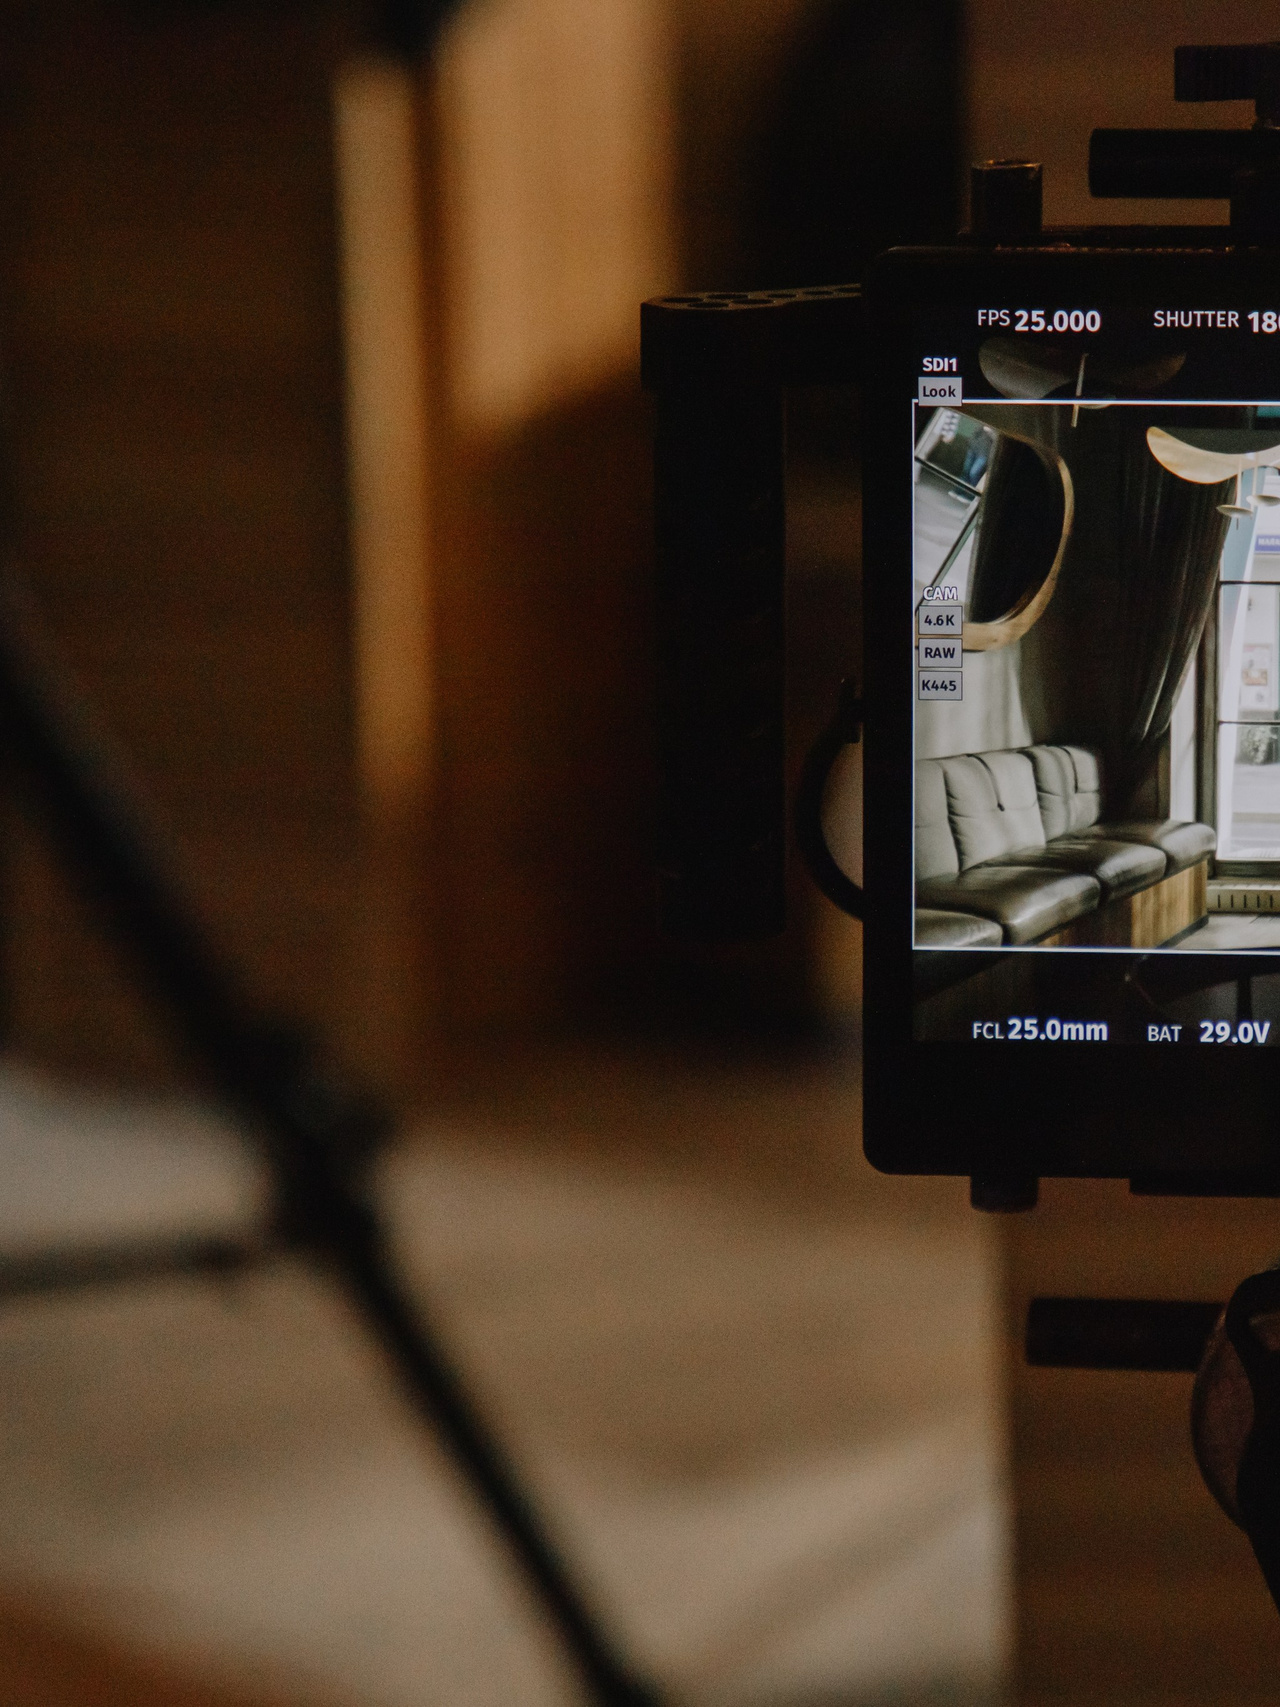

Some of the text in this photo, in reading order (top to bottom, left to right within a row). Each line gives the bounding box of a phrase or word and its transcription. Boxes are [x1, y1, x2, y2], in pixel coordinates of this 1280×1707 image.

[978, 310, 1101, 333] FPS 25.000
[1154, 310, 1239, 328] SHUTTER
[922, 357, 957, 372] SDI1
[922, 385, 957, 398] Look
[922, 586, 959, 601] CAM
[923, 614, 956, 627] 4.6K
[924, 646, 956, 659] RAW
[921, 679, 957, 692] K445
[972, 1018, 1108, 1042] FCL 25.0mm
[1147, 1021, 1271, 1044] BAT 29.0V
